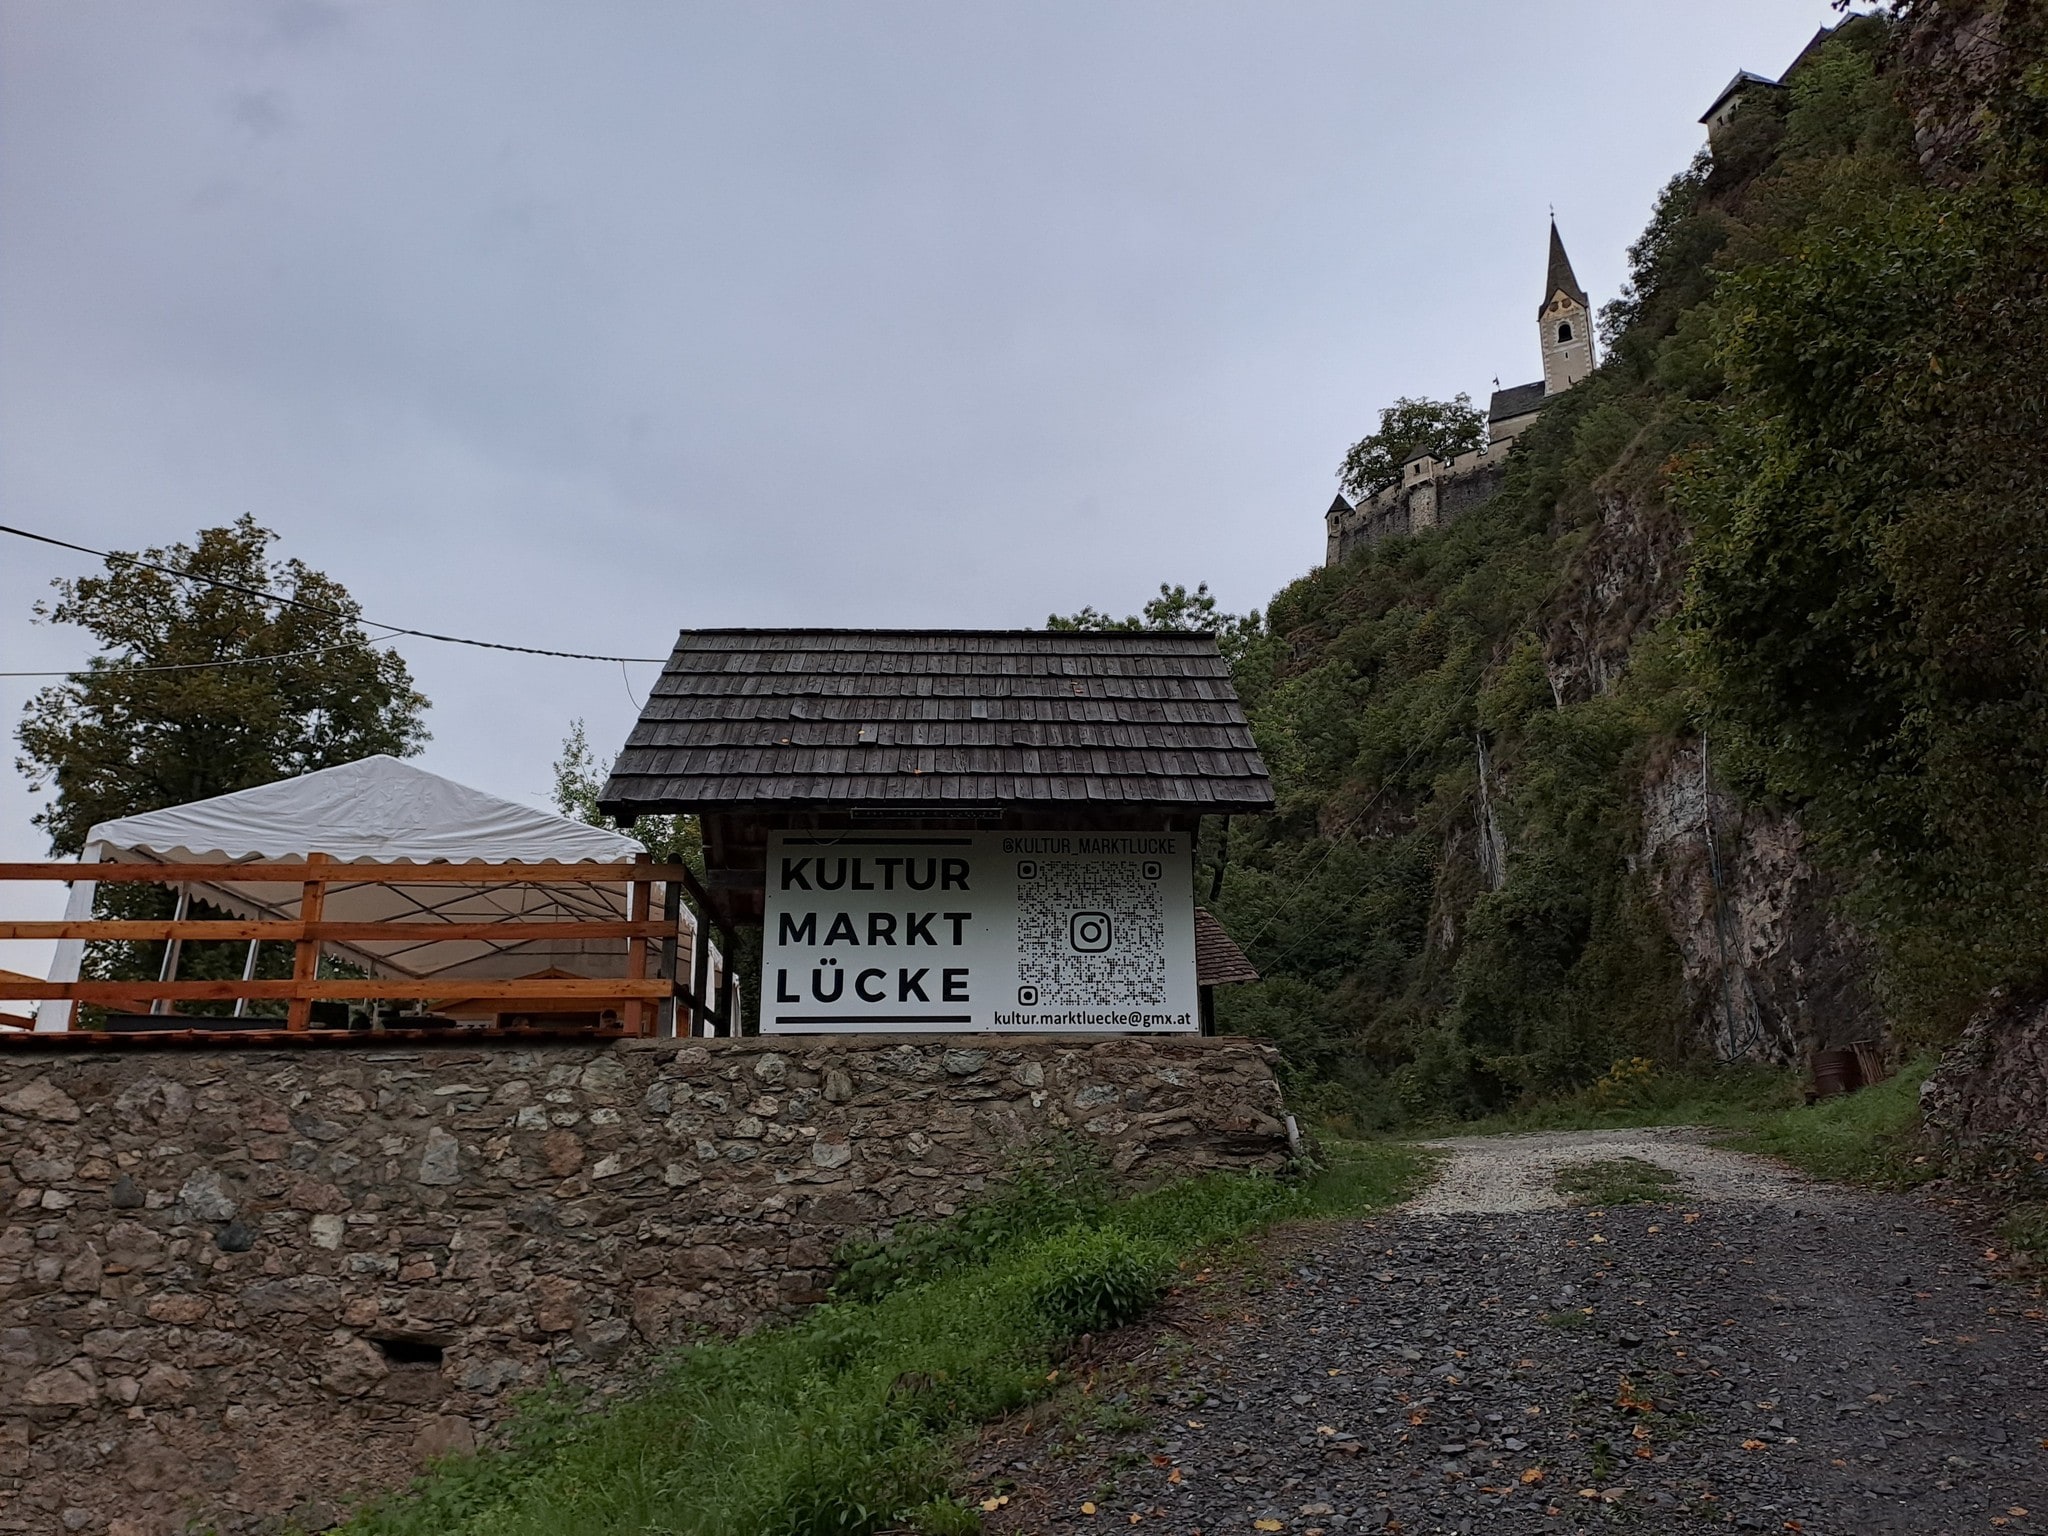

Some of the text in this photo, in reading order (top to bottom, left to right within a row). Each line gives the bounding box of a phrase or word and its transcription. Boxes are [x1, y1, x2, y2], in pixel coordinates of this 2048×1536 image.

[780, 858, 970, 890] KULTUR
[778, 912, 971, 945] MARKT
[776, 958, 970, 1002] LÜCKE
[994, 1010, 1191, 1028] kultur.marktluecke@gmx.at
